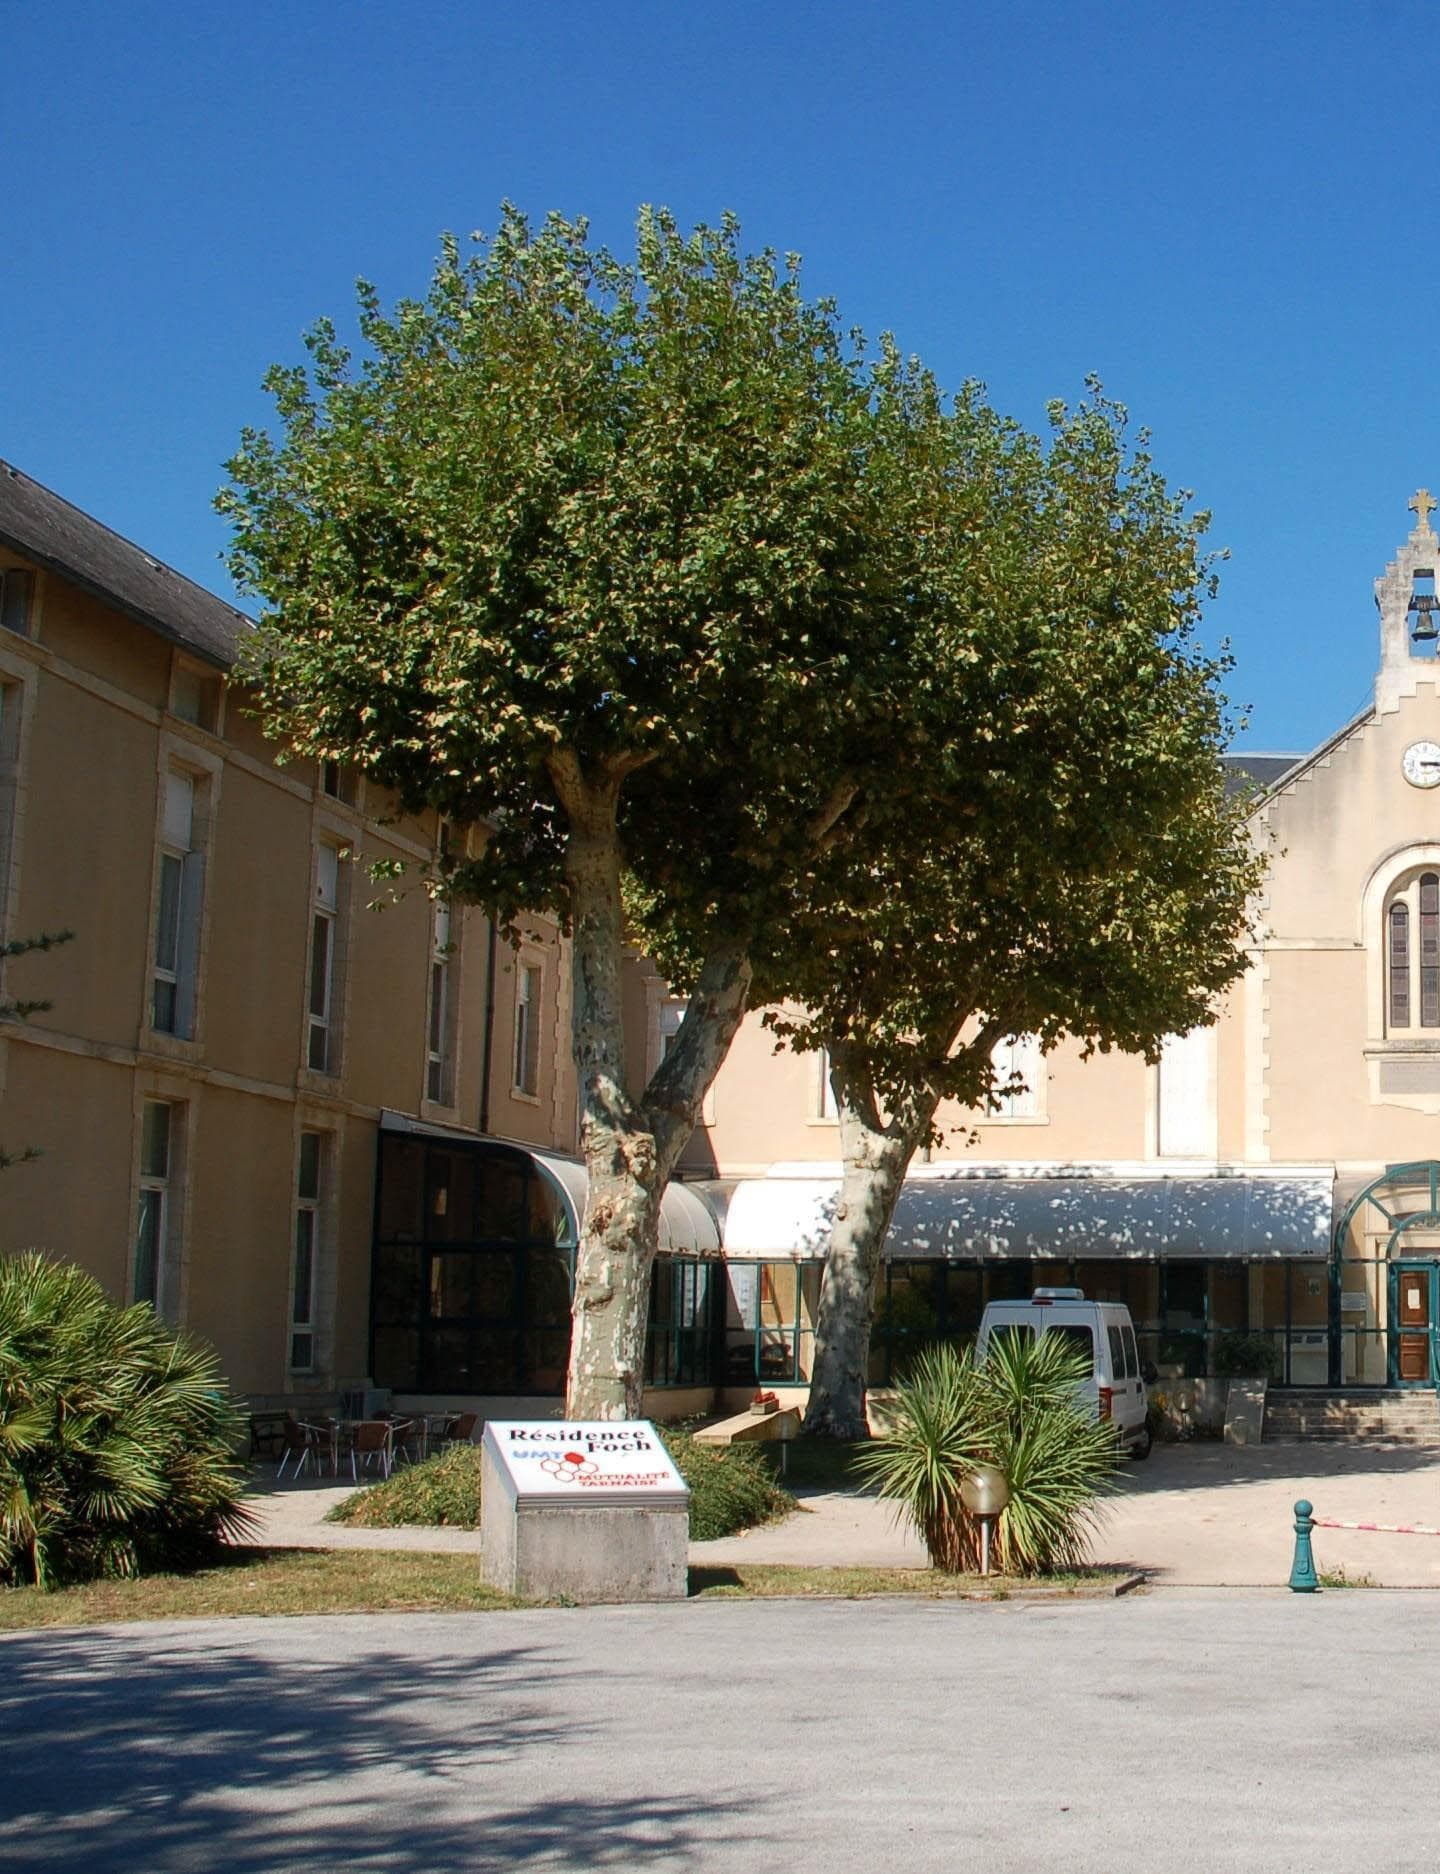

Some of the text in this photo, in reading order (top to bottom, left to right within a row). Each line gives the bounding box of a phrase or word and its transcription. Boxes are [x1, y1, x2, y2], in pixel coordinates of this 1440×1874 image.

[509, 1429, 646, 1441] Résidence
[587, 1440, 652, 1453] Foch
[512, 1450, 563, 1460] UMT
